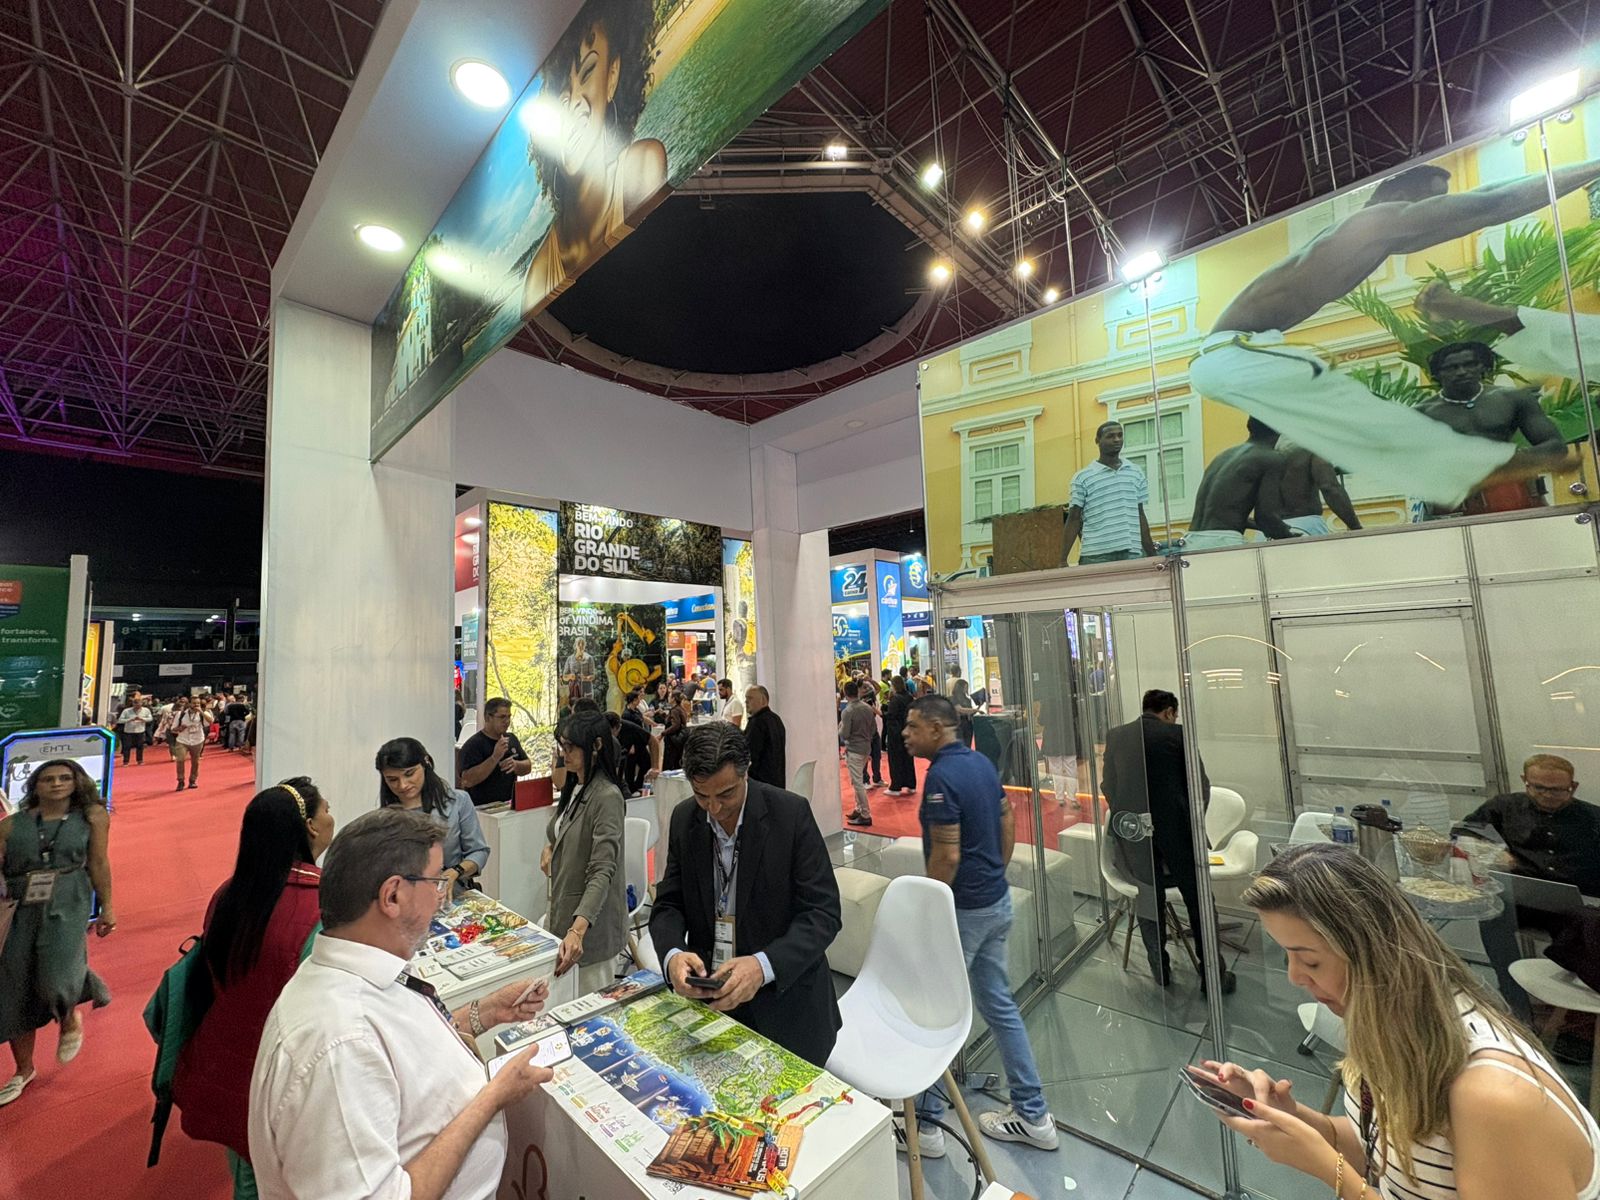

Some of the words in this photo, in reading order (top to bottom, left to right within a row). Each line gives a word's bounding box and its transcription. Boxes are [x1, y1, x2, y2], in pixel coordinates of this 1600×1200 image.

[575, 510, 634, 528] BEM-VINDO
[574, 522, 603, 540] RIO
[574, 539, 641, 560] GRANDE
[574, 555, 600, 571] DO
[603, 559, 633, 574] SUL
[571, 615, 613, 626] VINDIMA
[558, 626, 593, 636] BRASIL
